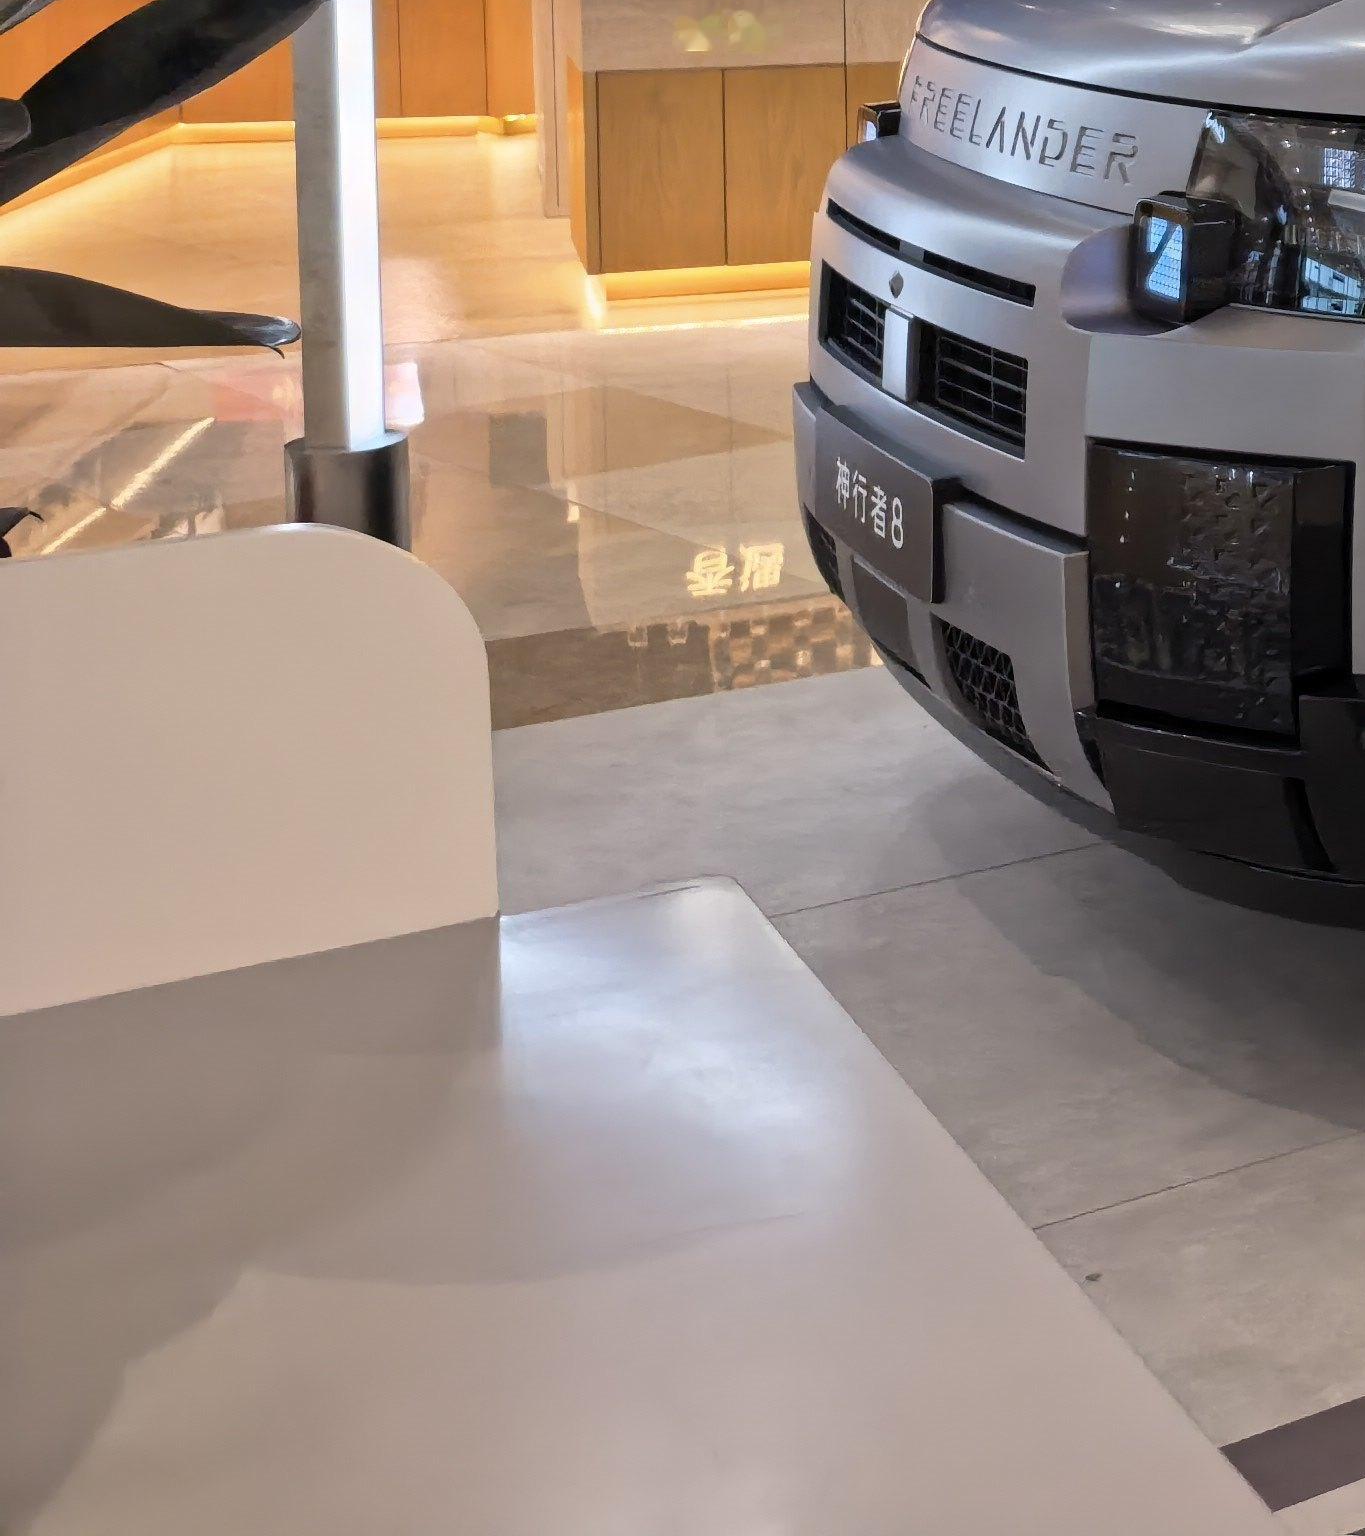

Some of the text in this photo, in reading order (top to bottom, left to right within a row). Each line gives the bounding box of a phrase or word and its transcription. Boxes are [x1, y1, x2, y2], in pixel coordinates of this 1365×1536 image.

[910, 75, 1139, 185] FREELANDER
[835, 456, 904, 550] 神行者8
